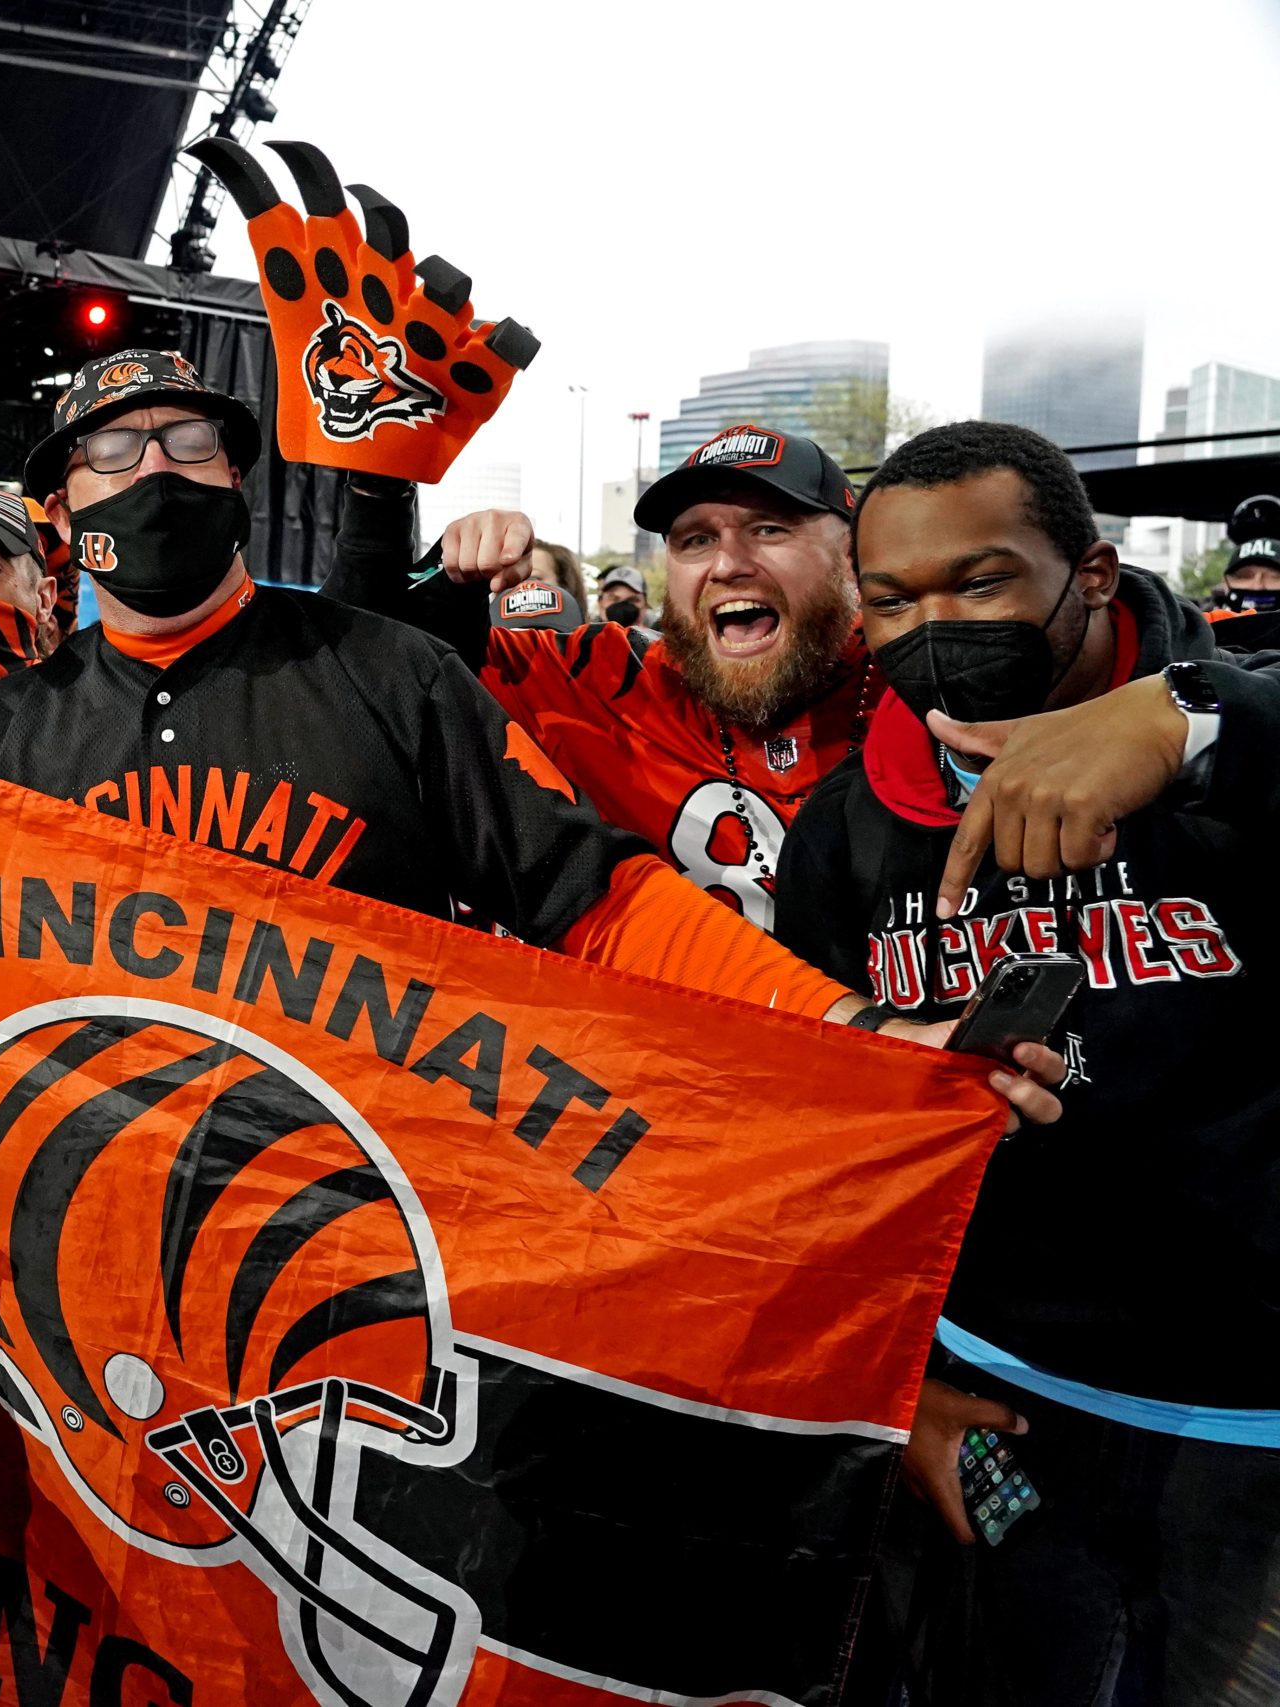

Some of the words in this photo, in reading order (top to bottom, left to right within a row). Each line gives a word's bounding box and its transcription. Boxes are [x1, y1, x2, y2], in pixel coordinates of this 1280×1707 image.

[699, 435, 769, 464] CINCINNATI
[712, 452, 746, 464] BENGALS
[78, 532, 119, 572] B
[1239, 539, 1277, 559] BAL
[866, 897, 1244, 1011] BUCKEYES
